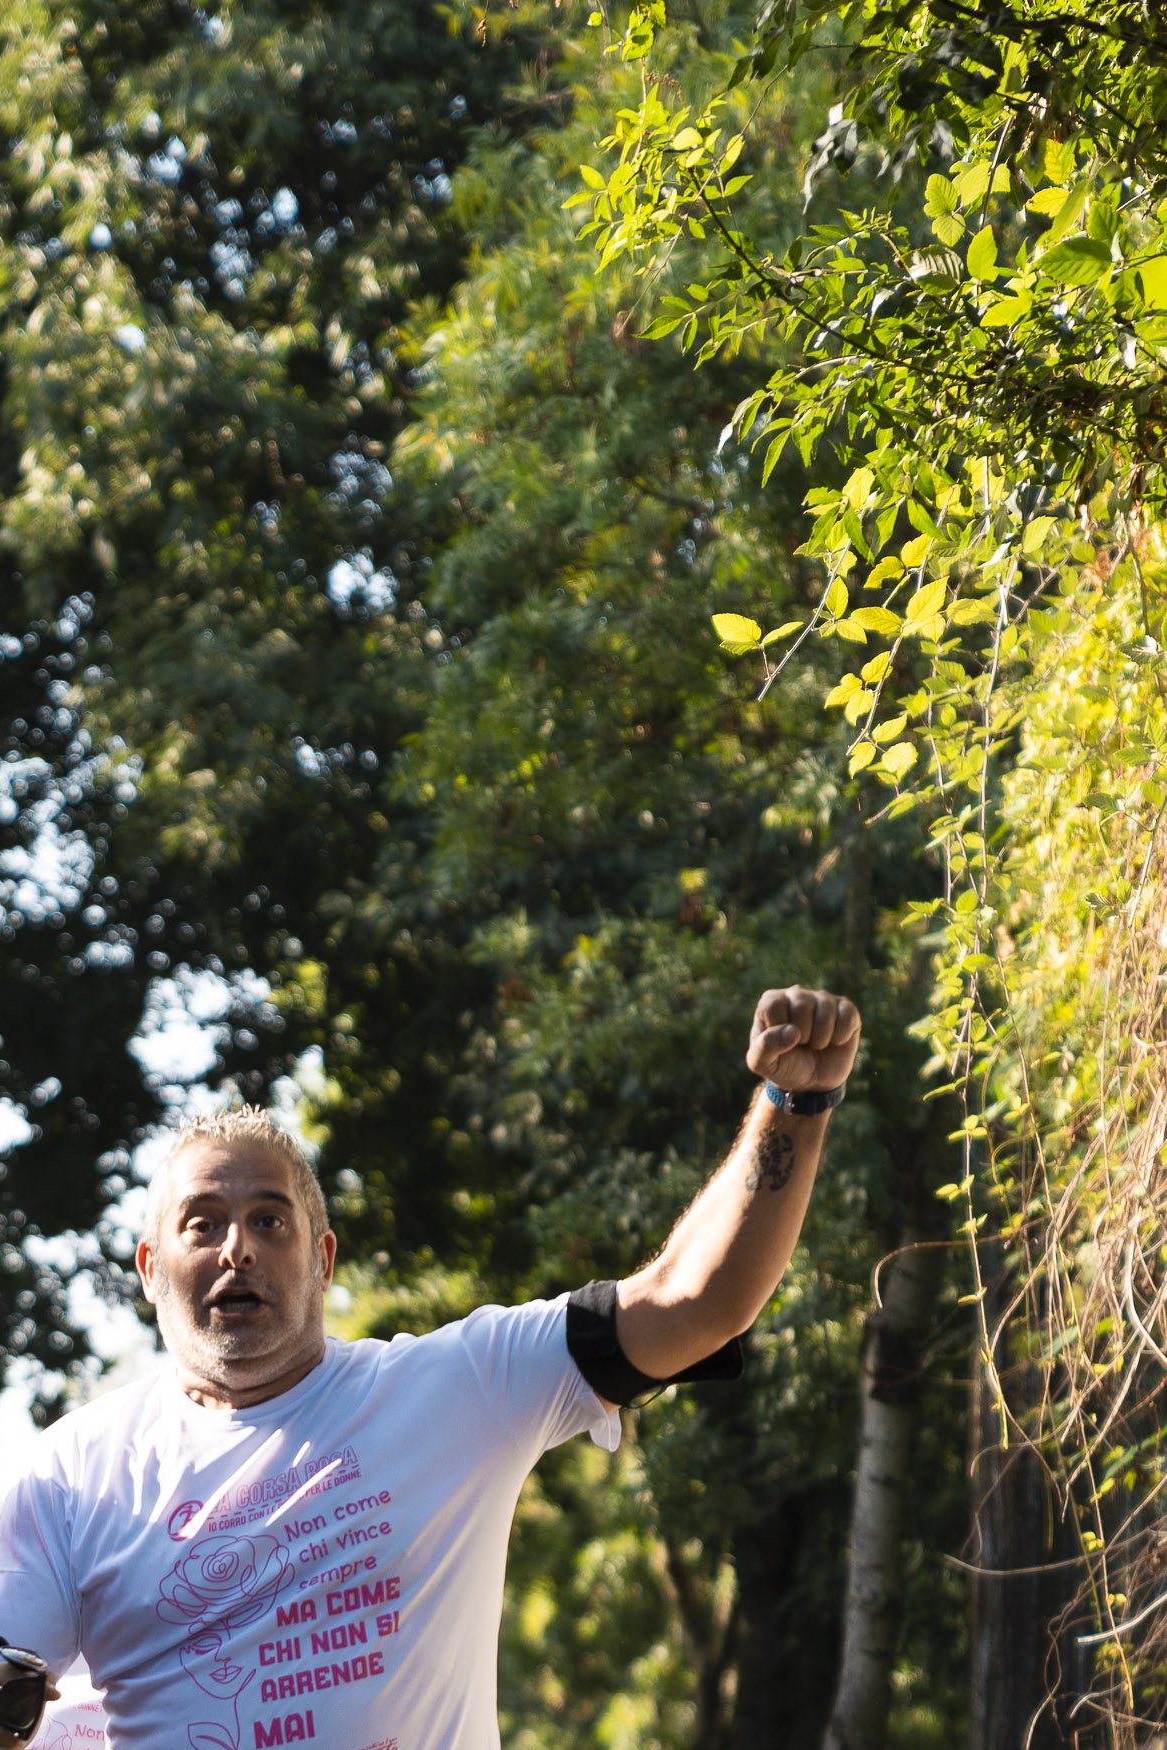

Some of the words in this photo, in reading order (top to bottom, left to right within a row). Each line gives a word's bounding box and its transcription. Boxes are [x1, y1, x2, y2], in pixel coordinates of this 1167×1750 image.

[208, 1521, 217, 1533] IO
[219, 1515, 247, 1532] CORRO
[248, 1509, 265, 1523] CON
[322, 1479, 334, 1492] LE
[334, 1468, 362, 1487] DONNE
[235, 1466, 303, 1509] CORSA
[283, 1515, 327, 1542] Non
[333, 1490, 392, 1521] come
[298, 1539, 329, 1563] chi
[336, 1521, 393, 1550] vince
[298, 1555, 378, 1590] sempre
[276, 1599, 317, 1627] MA
[326, 1576, 401, 1616] COME
[258, 1636, 302, 1667] CHI
[310, 1620, 368, 1655] NON
[375, 1610, 400, 1637] SI
[260, 1651, 385, 1703] ARRENDE
[74, 1723, 105, 1741] Non
[253, 1709, 315, 1750] MAI
